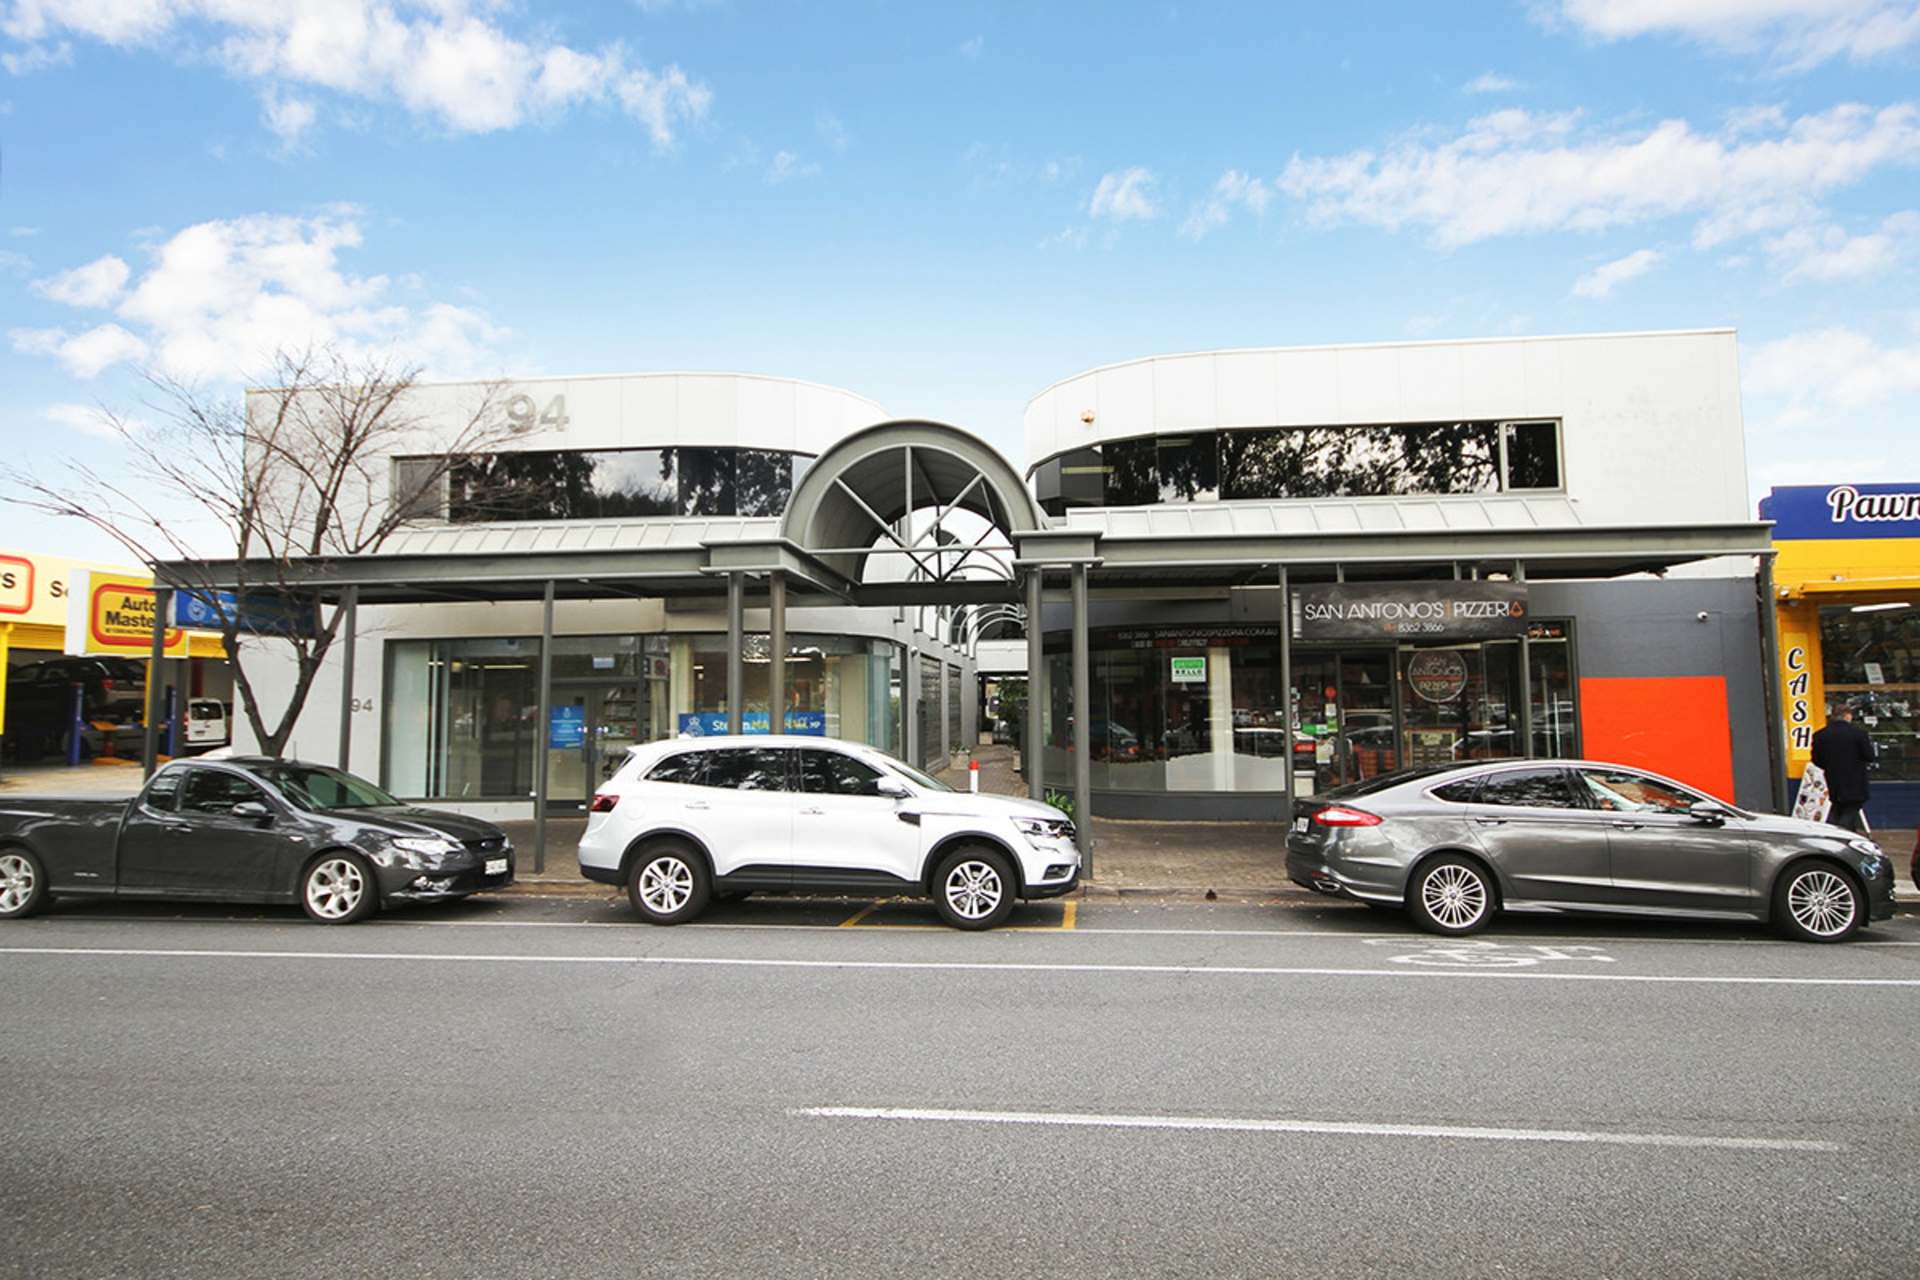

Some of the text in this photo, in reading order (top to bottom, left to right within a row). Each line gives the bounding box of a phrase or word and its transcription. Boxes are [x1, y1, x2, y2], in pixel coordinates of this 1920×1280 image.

[507, 394, 569, 433] 94
[121, 596, 156, 612] Auto
[1305, 603, 1343, 620] SAN
[1347, 602, 1444, 619] ANTONIO'S
[105, 611, 155, 627] Maste
[350, 698, 373, 712] 94
[1787, 647, 1812, 748] CASH
